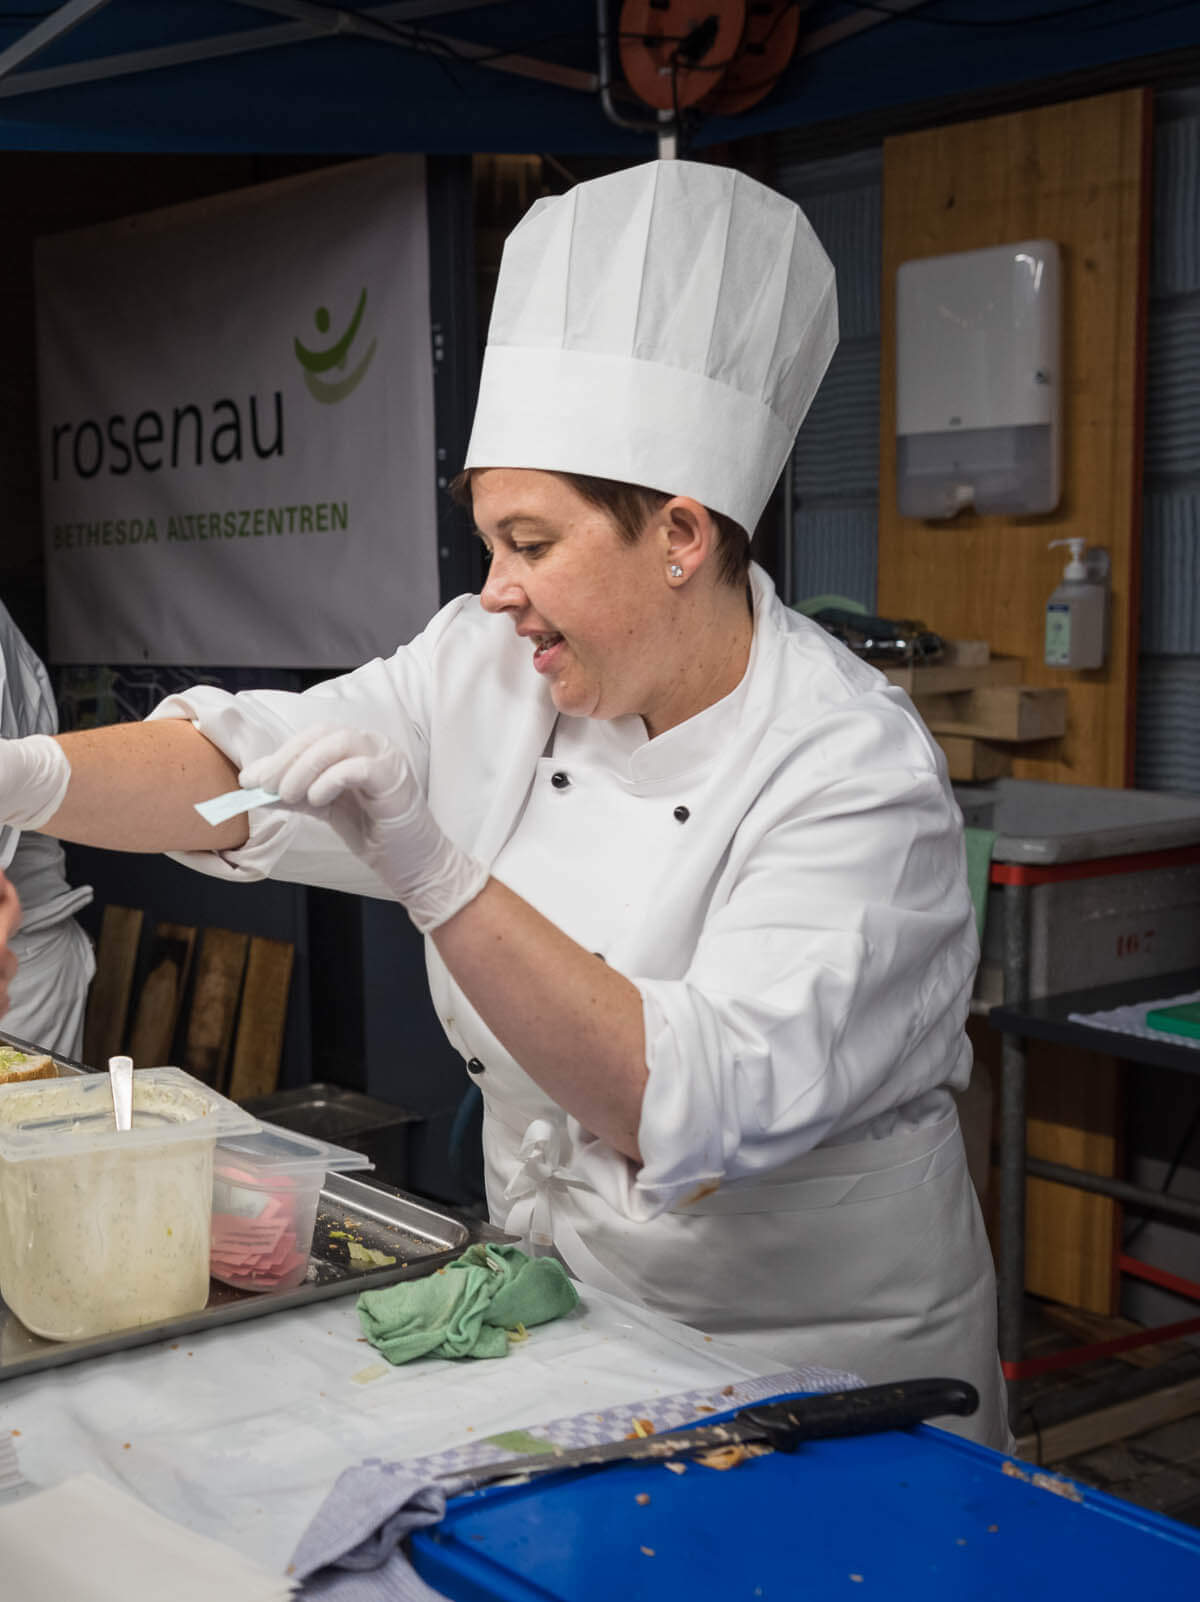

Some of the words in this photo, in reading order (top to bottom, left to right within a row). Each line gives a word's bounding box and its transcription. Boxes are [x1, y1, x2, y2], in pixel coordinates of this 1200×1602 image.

[52, 391, 284, 481] rosenau
[53, 517, 159, 551] BETHESDA
[166, 503, 349, 542] ALTERSZENTREN
